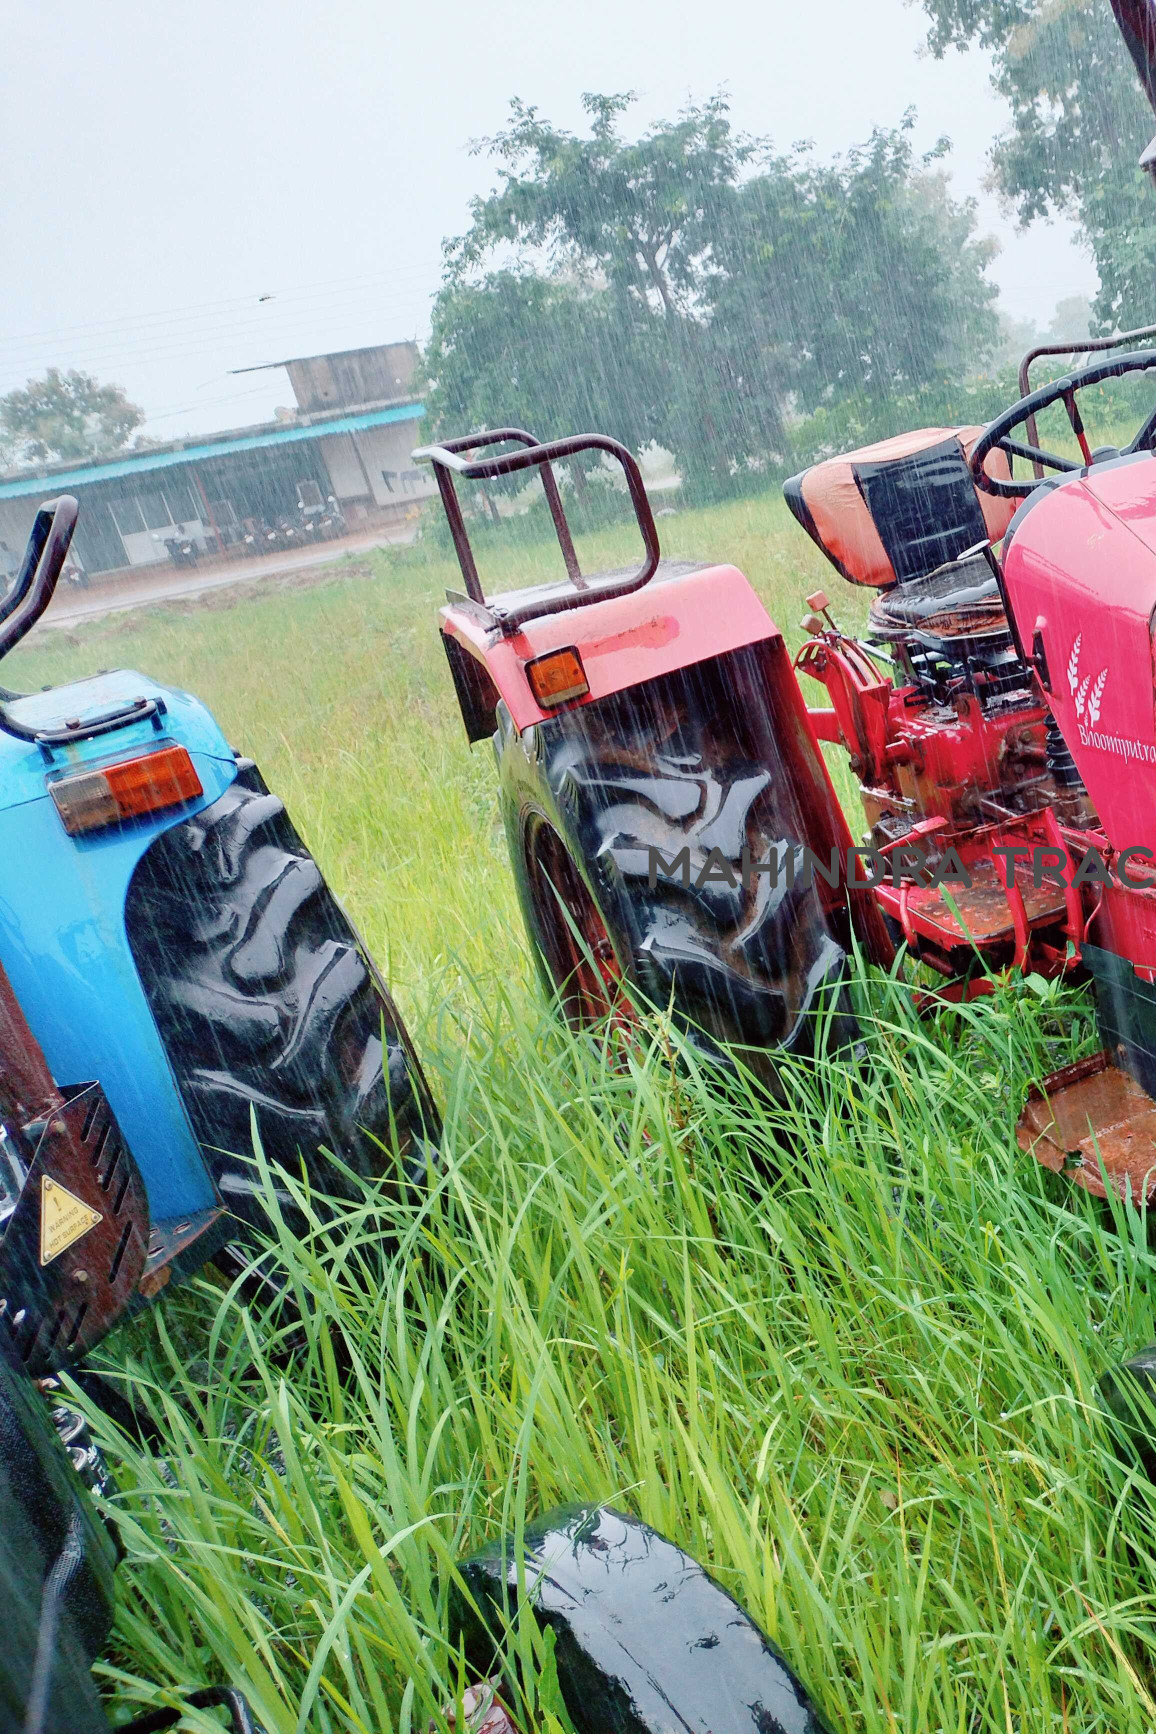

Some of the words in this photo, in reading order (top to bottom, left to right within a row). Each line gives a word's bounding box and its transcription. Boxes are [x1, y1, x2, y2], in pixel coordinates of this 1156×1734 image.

[1077, 723, 1156, 765] Bhoomiputra
[49, 1206, 79, 1233] WARNING
[50, 1235, 62, 1248] HOT
[62, 1214, 89, 1239] SURFACE
